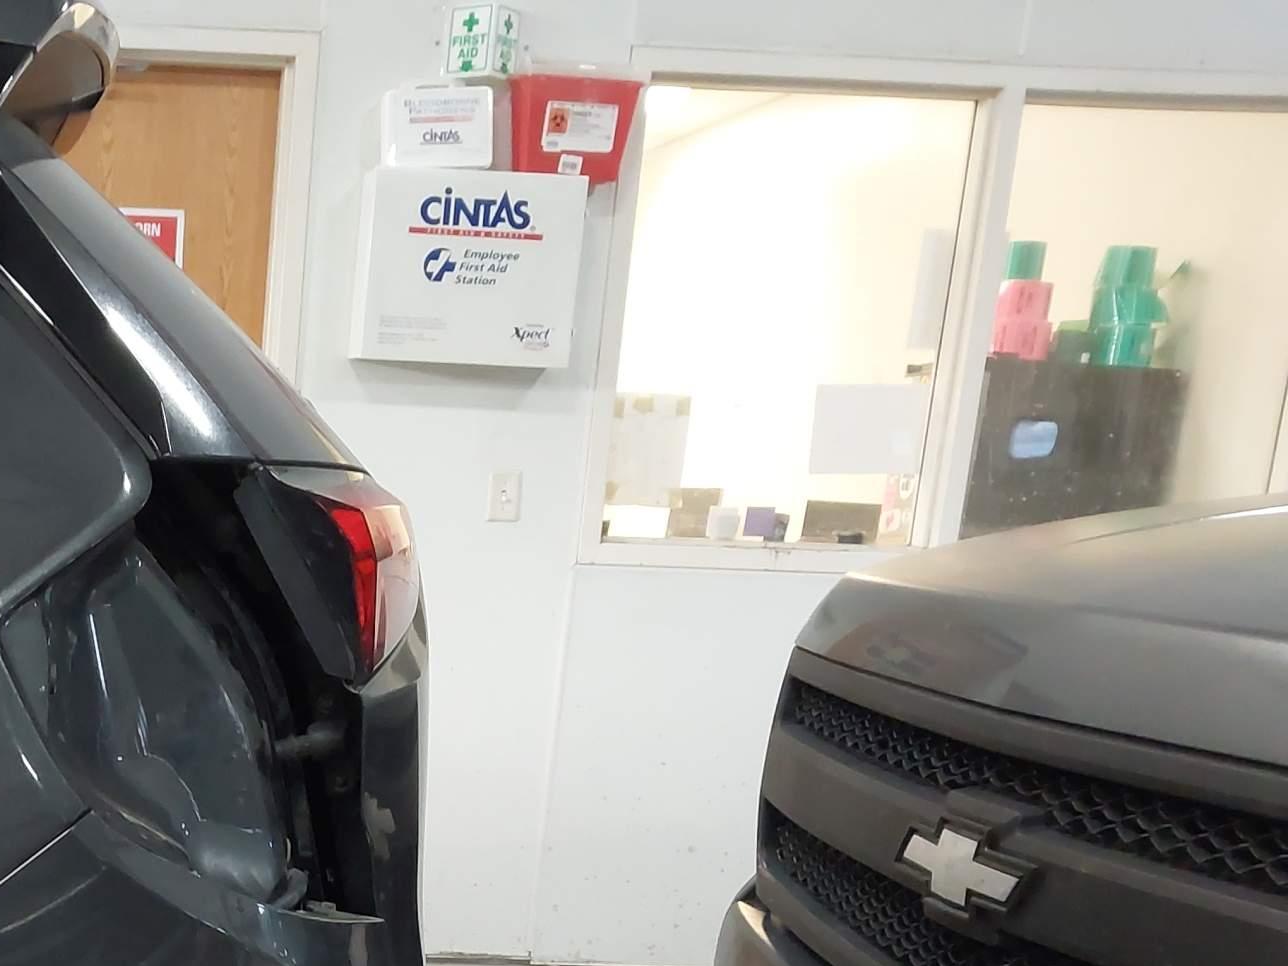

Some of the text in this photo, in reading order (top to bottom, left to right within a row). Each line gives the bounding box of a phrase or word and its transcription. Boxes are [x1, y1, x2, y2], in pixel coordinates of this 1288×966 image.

[452, 33, 487, 47] FIRST
[457, 47, 479, 59] AID
[463, 249, 520, 263] Employee
[459, 262, 509, 274] First Aid
[455, 275, 497, 286] Station
